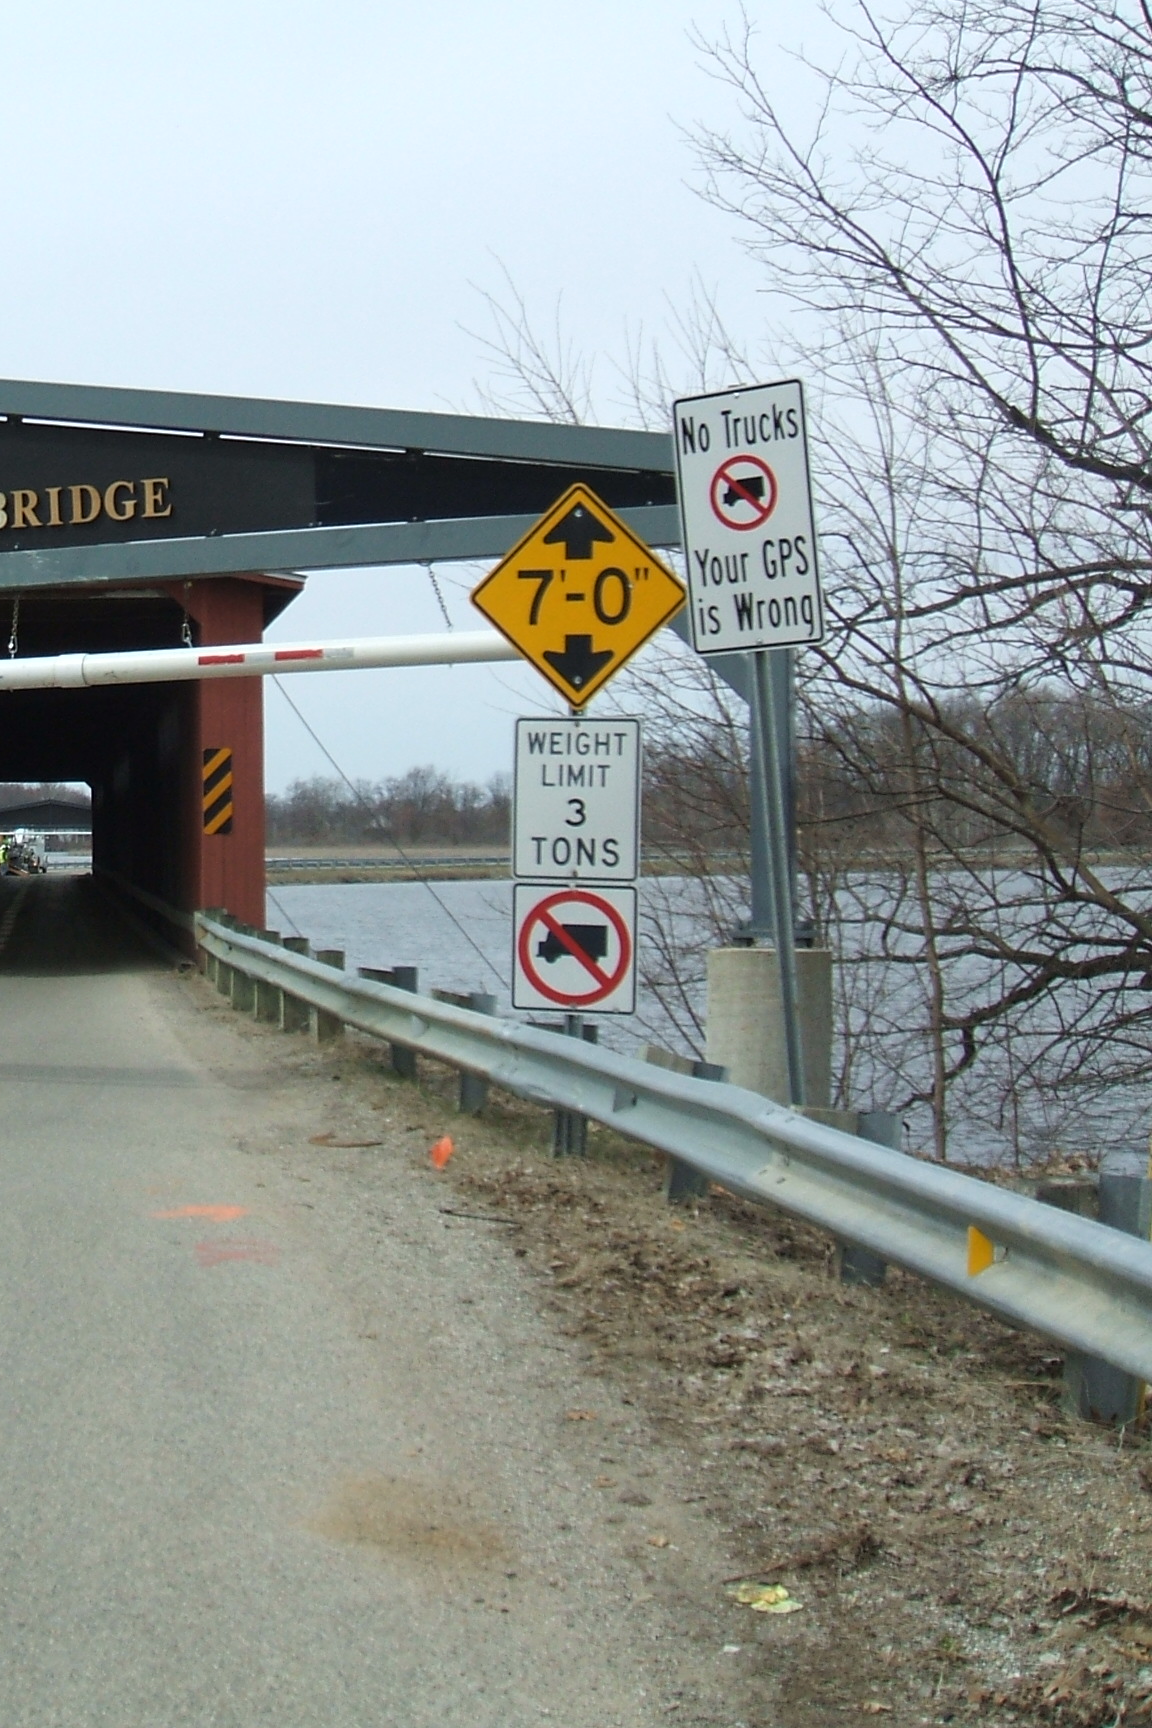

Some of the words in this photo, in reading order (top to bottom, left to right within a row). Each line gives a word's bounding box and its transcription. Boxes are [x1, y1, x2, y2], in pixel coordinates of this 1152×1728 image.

[681, 416, 710, 455] No
[721, 404, 798, 450] Trucks
[695, 548, 749, 588] Your
[762, 536, 810, 581] GPS
[517, 567, 650, 626] 7'-0"
[698, 598, 721, 636] is
[734, 592, 814, 637] Wrong
[528, 732, 628, 756] WEIGHT
[541, 765, 611, 788] LIMIT
[564, 799, 586, 827] 3
[531, 836, 620, 867] TONS
